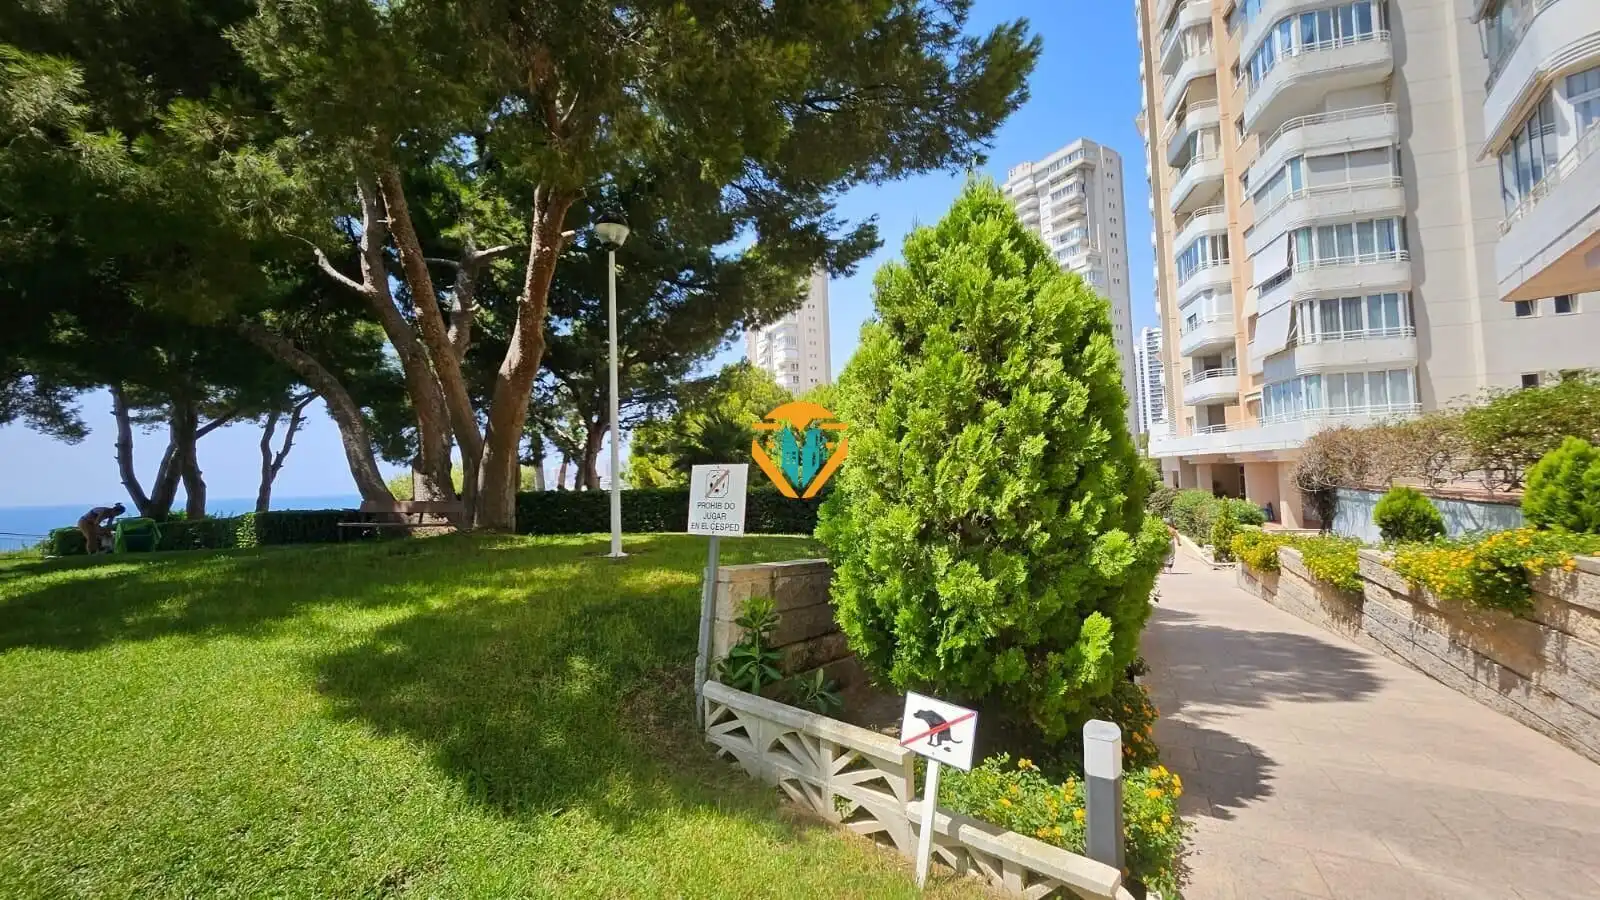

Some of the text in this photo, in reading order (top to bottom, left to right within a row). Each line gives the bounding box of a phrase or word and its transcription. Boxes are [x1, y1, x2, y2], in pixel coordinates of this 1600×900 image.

[697, 501, 736, 510] PROHIBDO
[703, 512, 727, 520] JUGAR
[691, 522, 740, 532] EN EL CESPED
